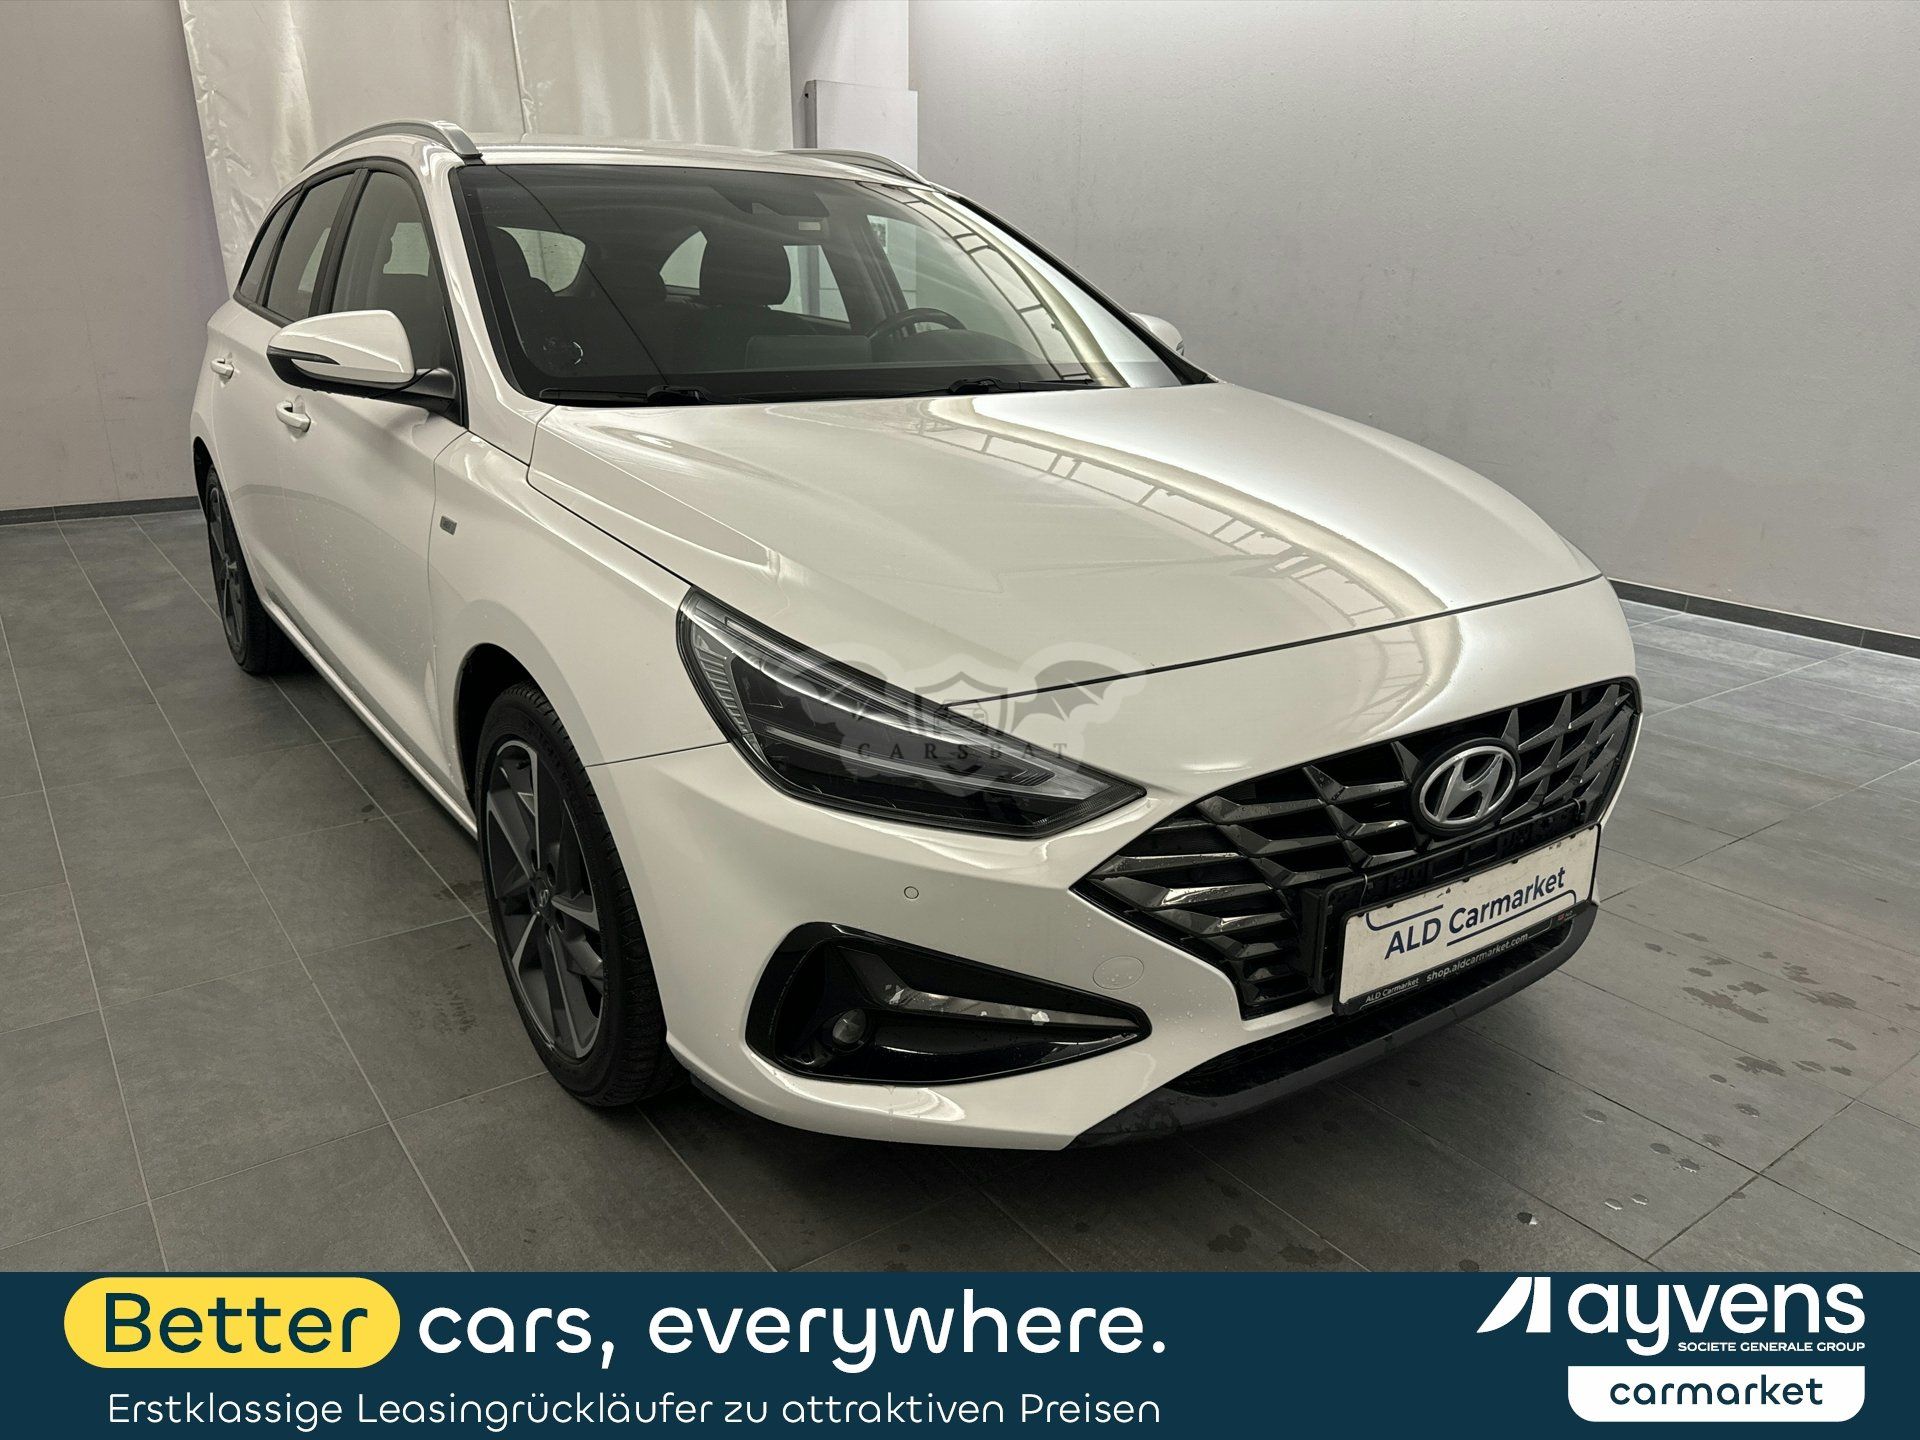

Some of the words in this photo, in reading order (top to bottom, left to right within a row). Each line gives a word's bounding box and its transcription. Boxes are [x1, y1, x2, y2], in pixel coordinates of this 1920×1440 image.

[1385, 917, 1441, 959] ALD
[1449, 867, 1565, 934] Carmarket
[1426, 932, 1528, 983] shop.aldcarmarket.com
[1365, 991, 1381, 1003] ALD
[1382, 978, 1419, 998] Carmarket
